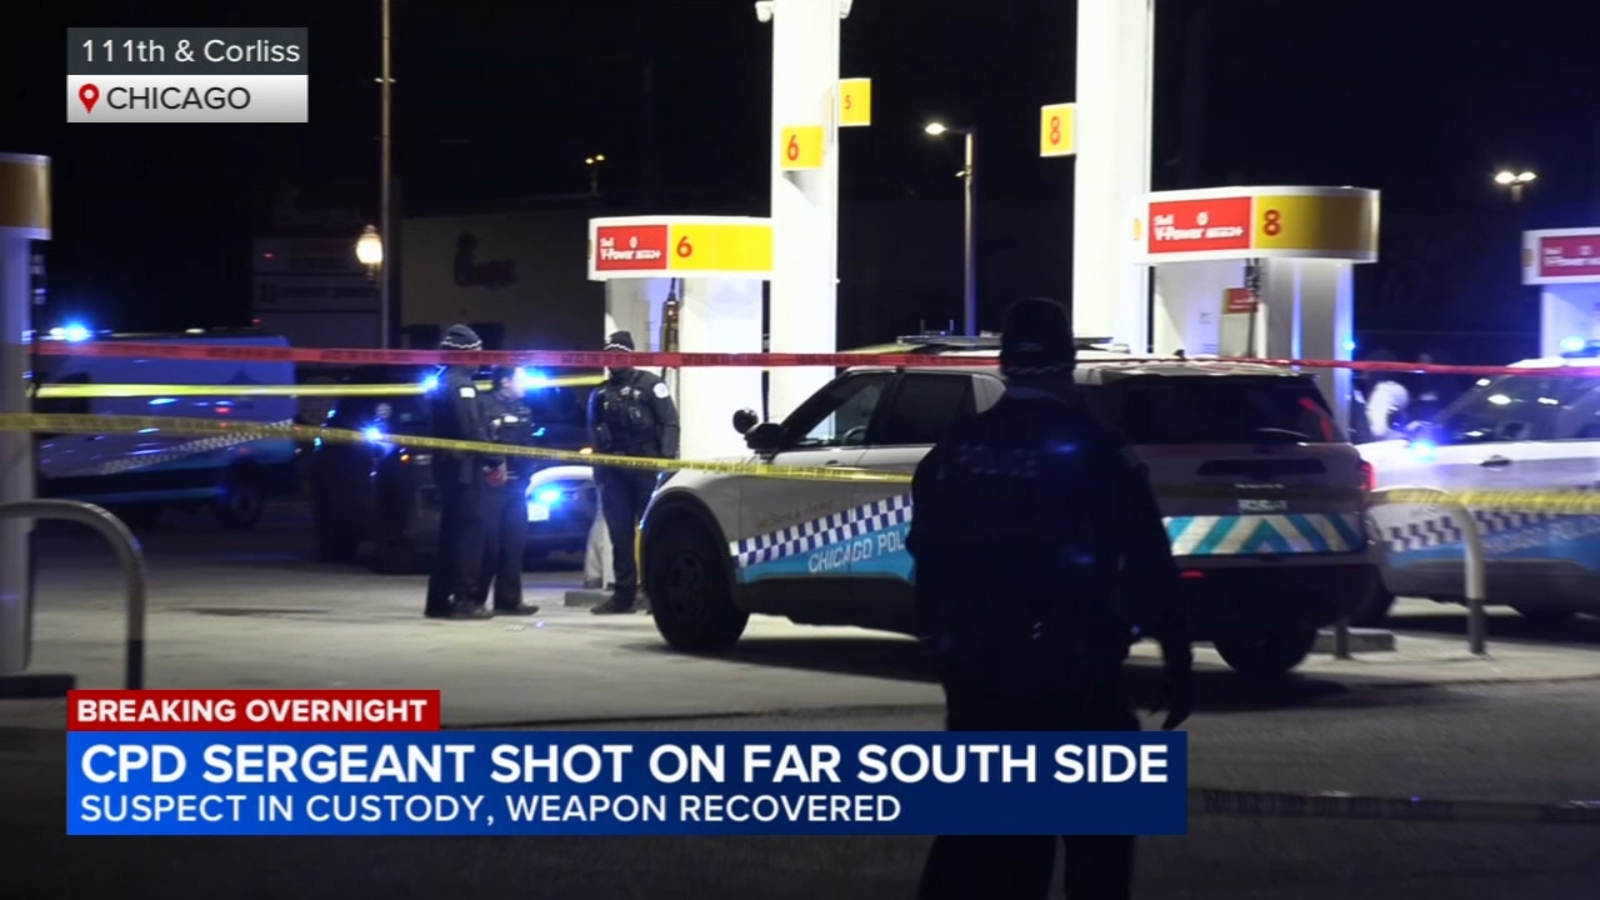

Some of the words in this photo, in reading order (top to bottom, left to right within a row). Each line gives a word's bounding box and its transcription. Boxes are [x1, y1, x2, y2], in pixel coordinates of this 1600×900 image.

[843, 94, 852, 111] 5
[1050, 115, 1061, 146] 8
[786, 133, 800, 161] 6
[1262, 209, 1281, 237] 8
[675, 235, 693, 259] 6
[957, 442, 1040, 479] POLCE
[808, 538, 873, 574] CHICAGO
